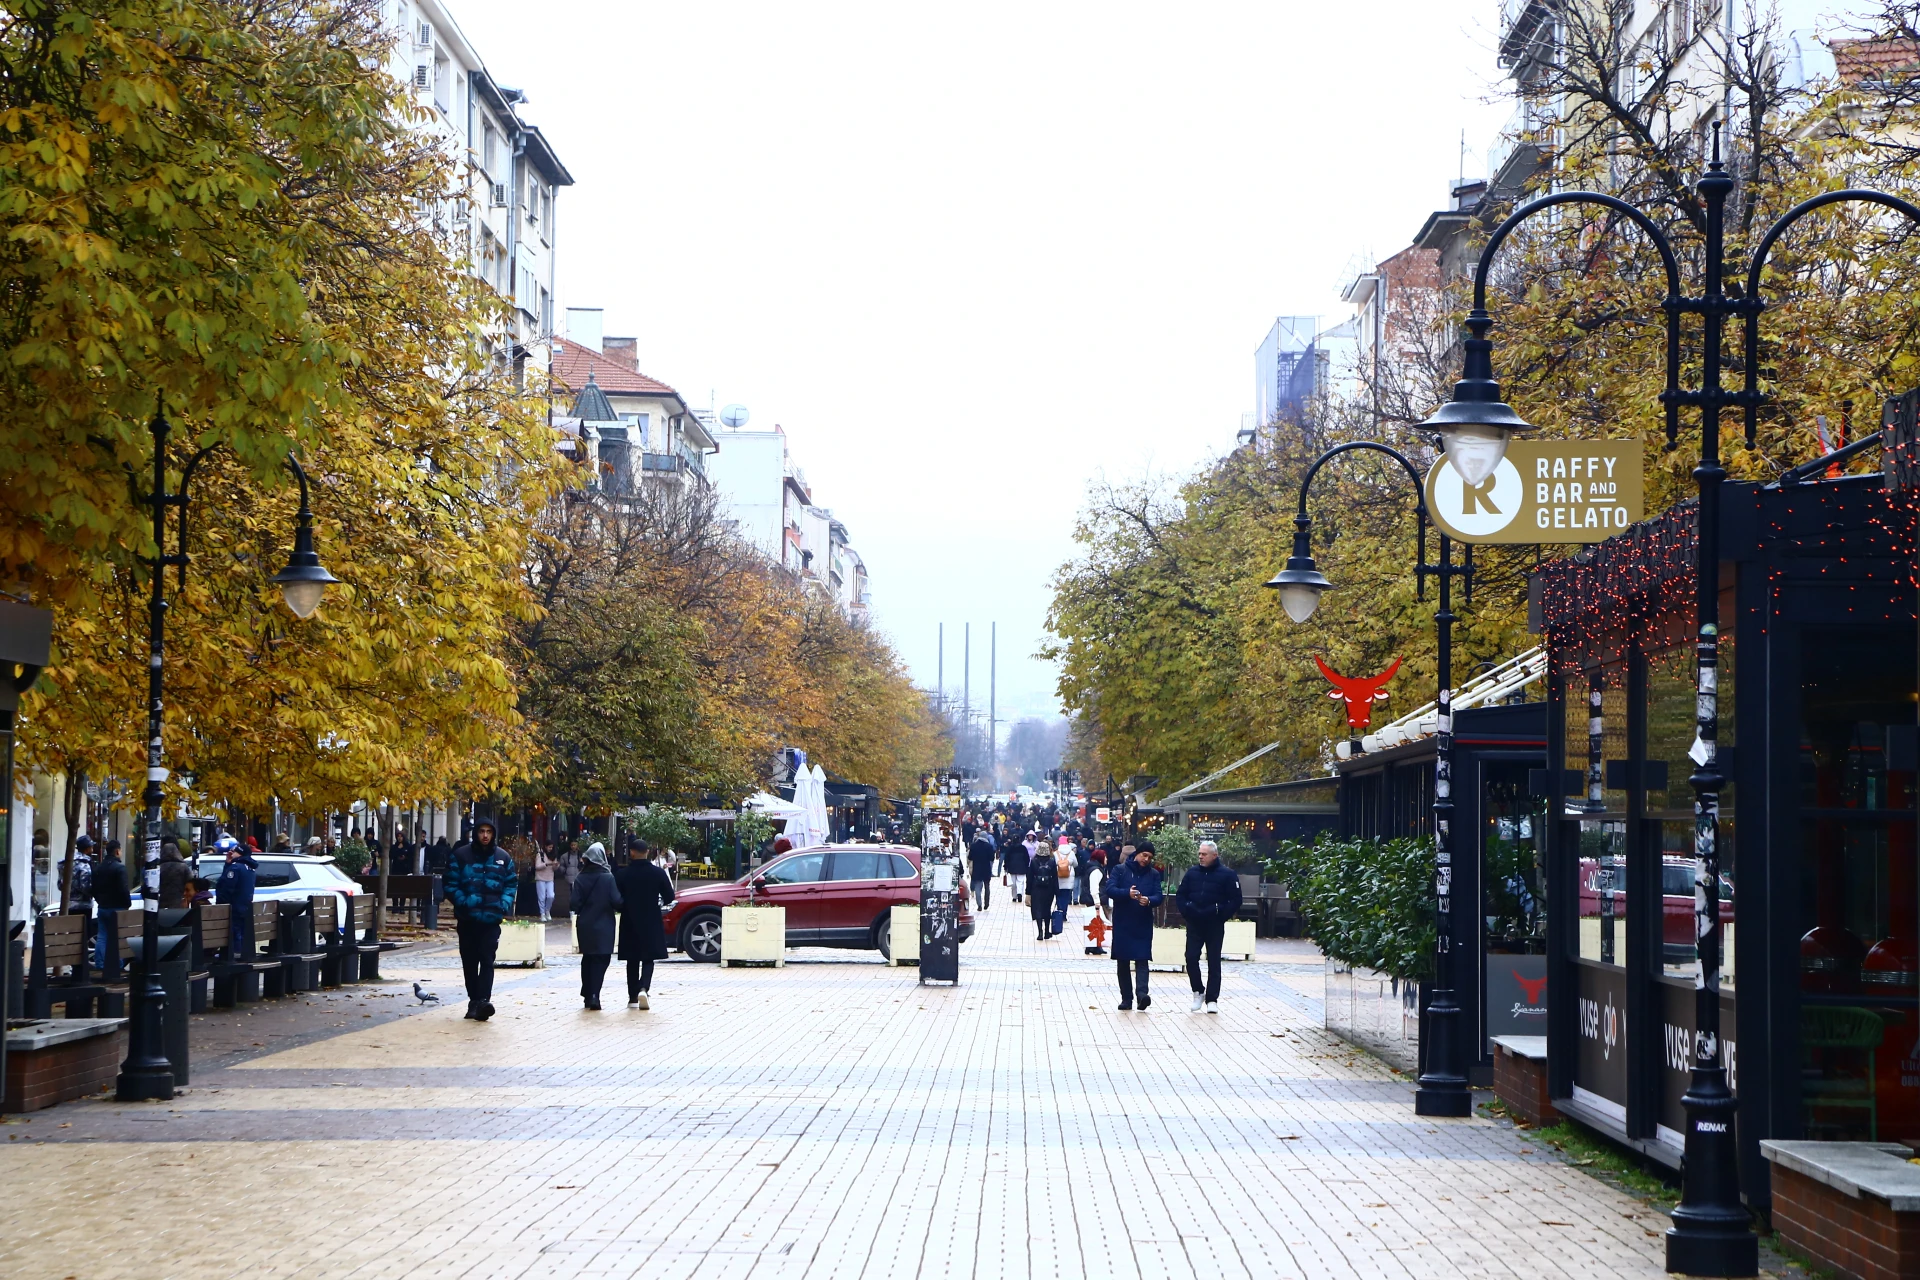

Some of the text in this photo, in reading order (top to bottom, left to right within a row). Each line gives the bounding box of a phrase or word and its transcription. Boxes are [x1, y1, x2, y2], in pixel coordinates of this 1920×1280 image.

[1536, 457, 1617, 479] RAFFY
[1536, 482, 1617, 504] BAR AND
[1536, 506, 1628, 529] GELATO
[1603, 991, 1617, 1060] glo
[1697, 1121, 1727, 1133] RENAK
